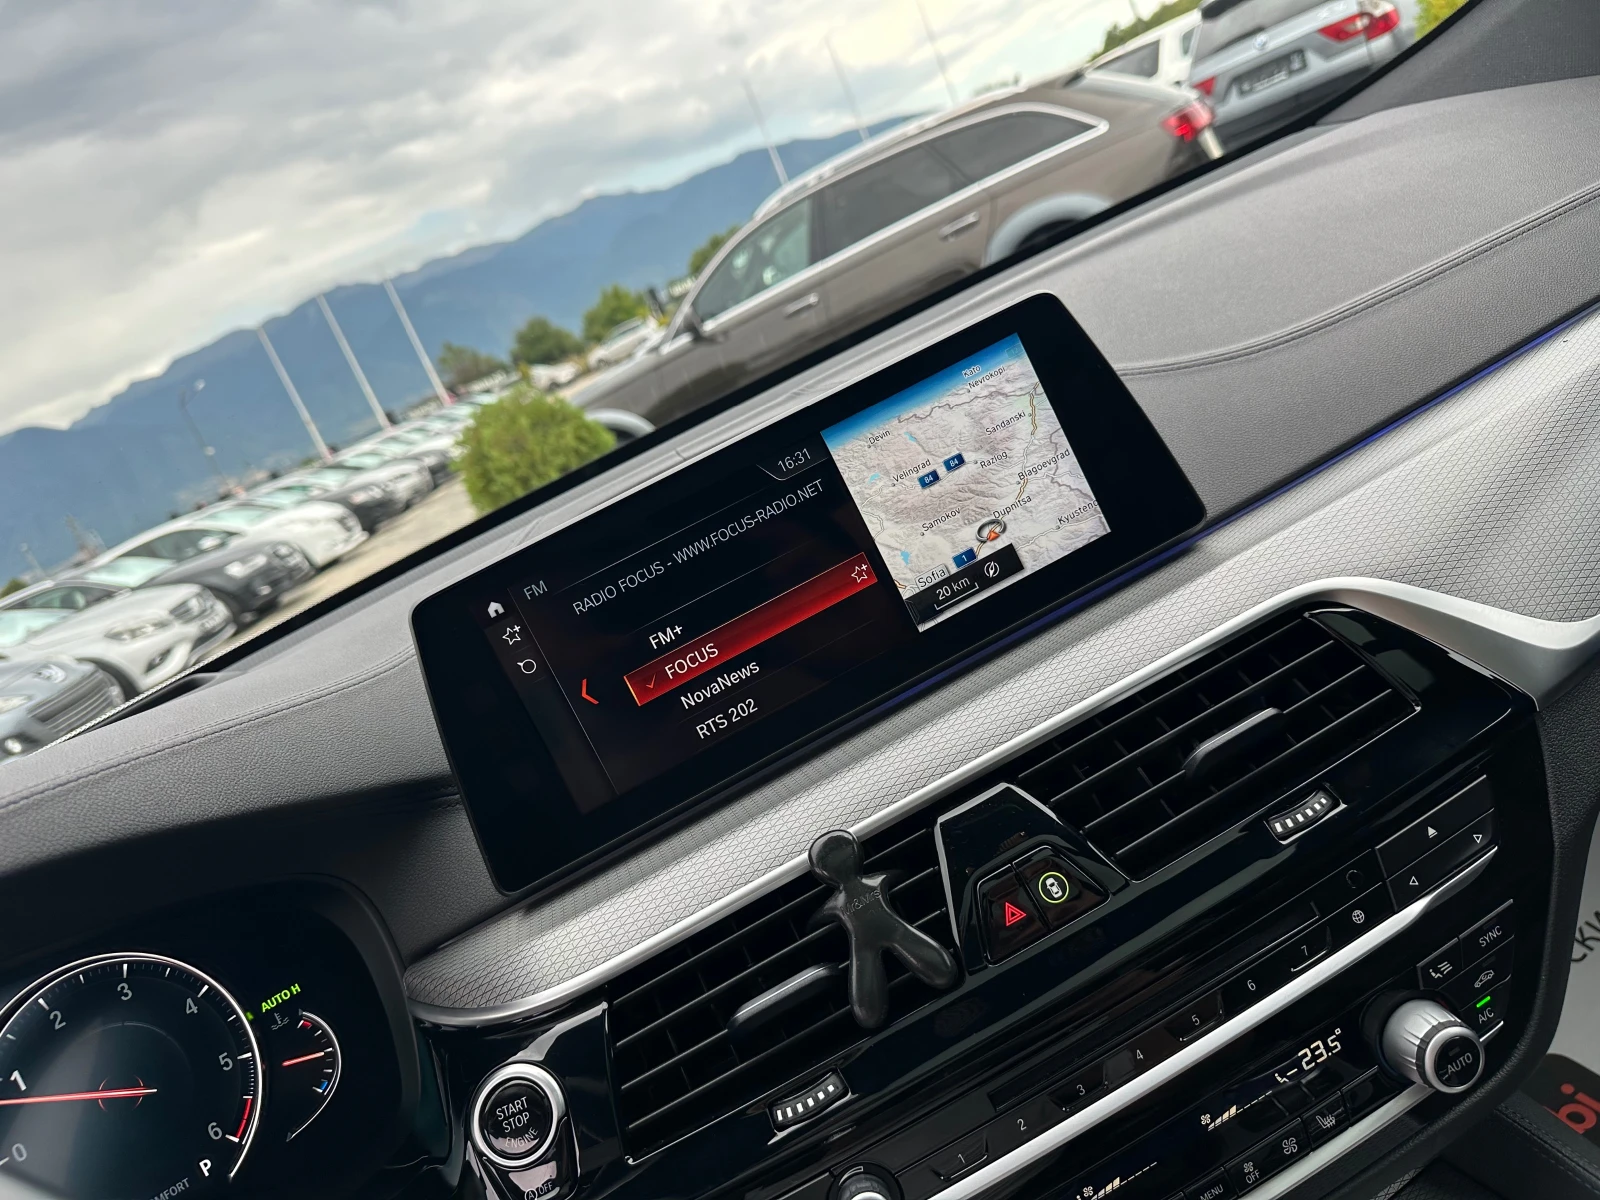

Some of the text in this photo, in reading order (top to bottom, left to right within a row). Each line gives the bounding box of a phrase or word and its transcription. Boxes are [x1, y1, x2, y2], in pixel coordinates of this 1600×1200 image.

[962, 364, 982, 378] Kato
[968, 366, 1007, 389] Nevrokopi
[985, 410, 1026, 436] Sandanski
[868, 429, 891, 446] Devin
[777, 448, 812, 472] 16:31
[949, 458, 959, 468] 84
[979, 450, 1008, 469] Razlog
[1017, 449, 1071, 481] Blagoevgrad
[892, 459, 932, 484] Velingrad
[924, 474, 934, 484] 84
[992, 495, 1032, 519] Dupnitsa
[921, 507, 961, 532] Samokov
[573, 585, 617, 615] RADIO
[618, 561, 665, 596] FOCUS
[673, 479, 824, 565] WWW.FOCUS-RADIO.NET
[918, 567, 947, 588] Sofia
[524, 581, 548, 600] FM
[936, 576, 971, 600] 20 km
[649, 623, 684, 649] FM+
[665, 642, 719, 680] FOCUS
[681, 660, 760, 710] NovaNews
[696, 698, 759, 739] RTS 202
[1478, 925, 1502, 948] SYNC
[1301, 944, 1310, 957] 7
[117, 982, 133, 1001] 3
[1247, 979, 1257, 992] 6
[185, 997, 199, 1017] 4
[260, 983, 302, 1013] AUTO H
[50, 1011, 67, 1030] 2
[1191, 1014, 1201, 1027] 5
[1478, 1007, 1494, 1024] A/C
[218, 1052, 233, 1071] 5
[1135, 1048, 1145, 1062] 4
[1447, 1052, 1473, 1075] AUTO
[10, 1070, 28, 1092] 1
[1076, 1083, 1087, 1097] 3
[496, 1096, 528, 1121] START
[207, 1121, 223, 1141] 6
[502, 1111, 530, 1133] STOP
[1016, 1117, 1027, 1132] 2
[504, 1126, 539, 1149] ENGINE
[12, 1142, 28, 1163] 0
[957, 1153, 966, 1165] 1
[199, 1158, 212, 1177] P
[1245, 1168, 1261, 1185] OFF
[538, 1181, 553, 1195] OFF
[1199, 1183, 1224, 1200] MENU
